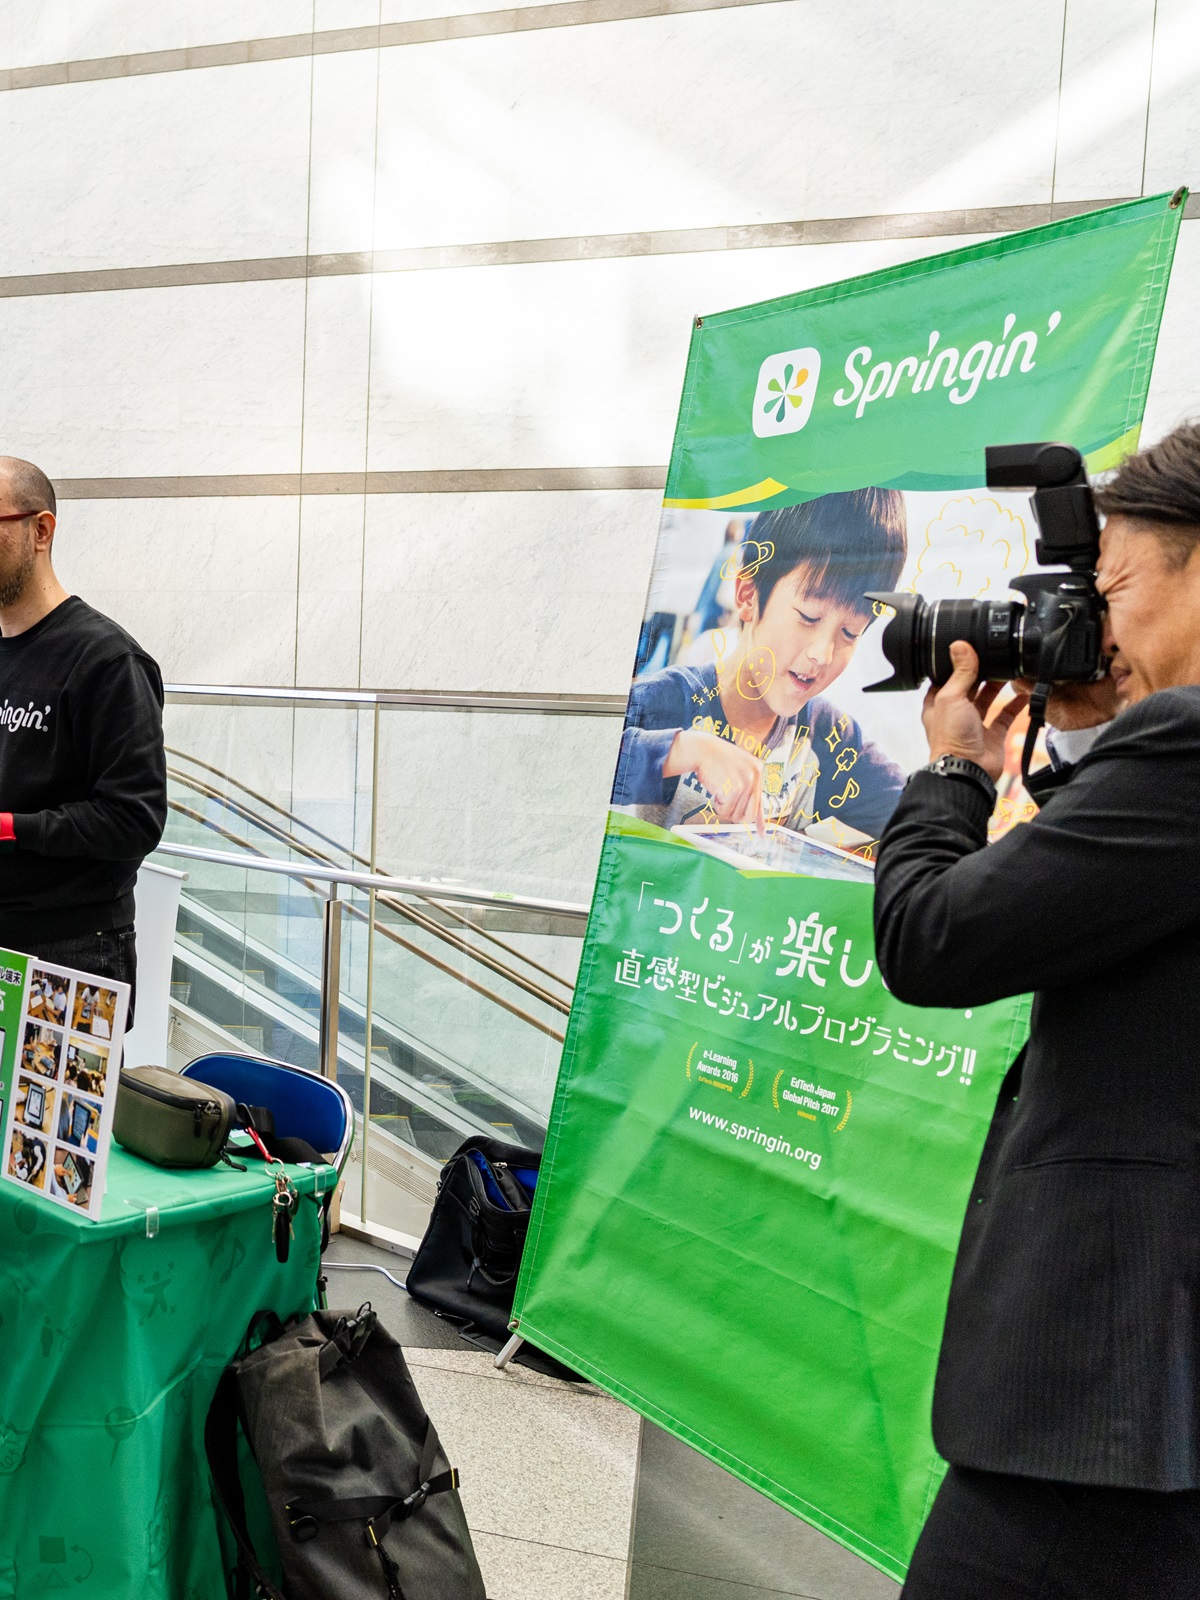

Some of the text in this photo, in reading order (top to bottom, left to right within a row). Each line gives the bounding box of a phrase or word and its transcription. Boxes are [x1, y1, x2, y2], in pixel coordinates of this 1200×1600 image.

[833, 311, 1062, 419] Springin'
[692, 715, 772, 763] CREATION!
[637, 881, 891, 992] 「つくる」が楽し
[696, 1060, 739, 1084] Awards 2016
[703, 1049, 738, 1071] e-Learning
[782, 1089, 840, 1117] Global Pitch 2017
[790, 1077, 836, 1101] EdTech Japan
[689, 1106, 822, 1171] www.springin.org
